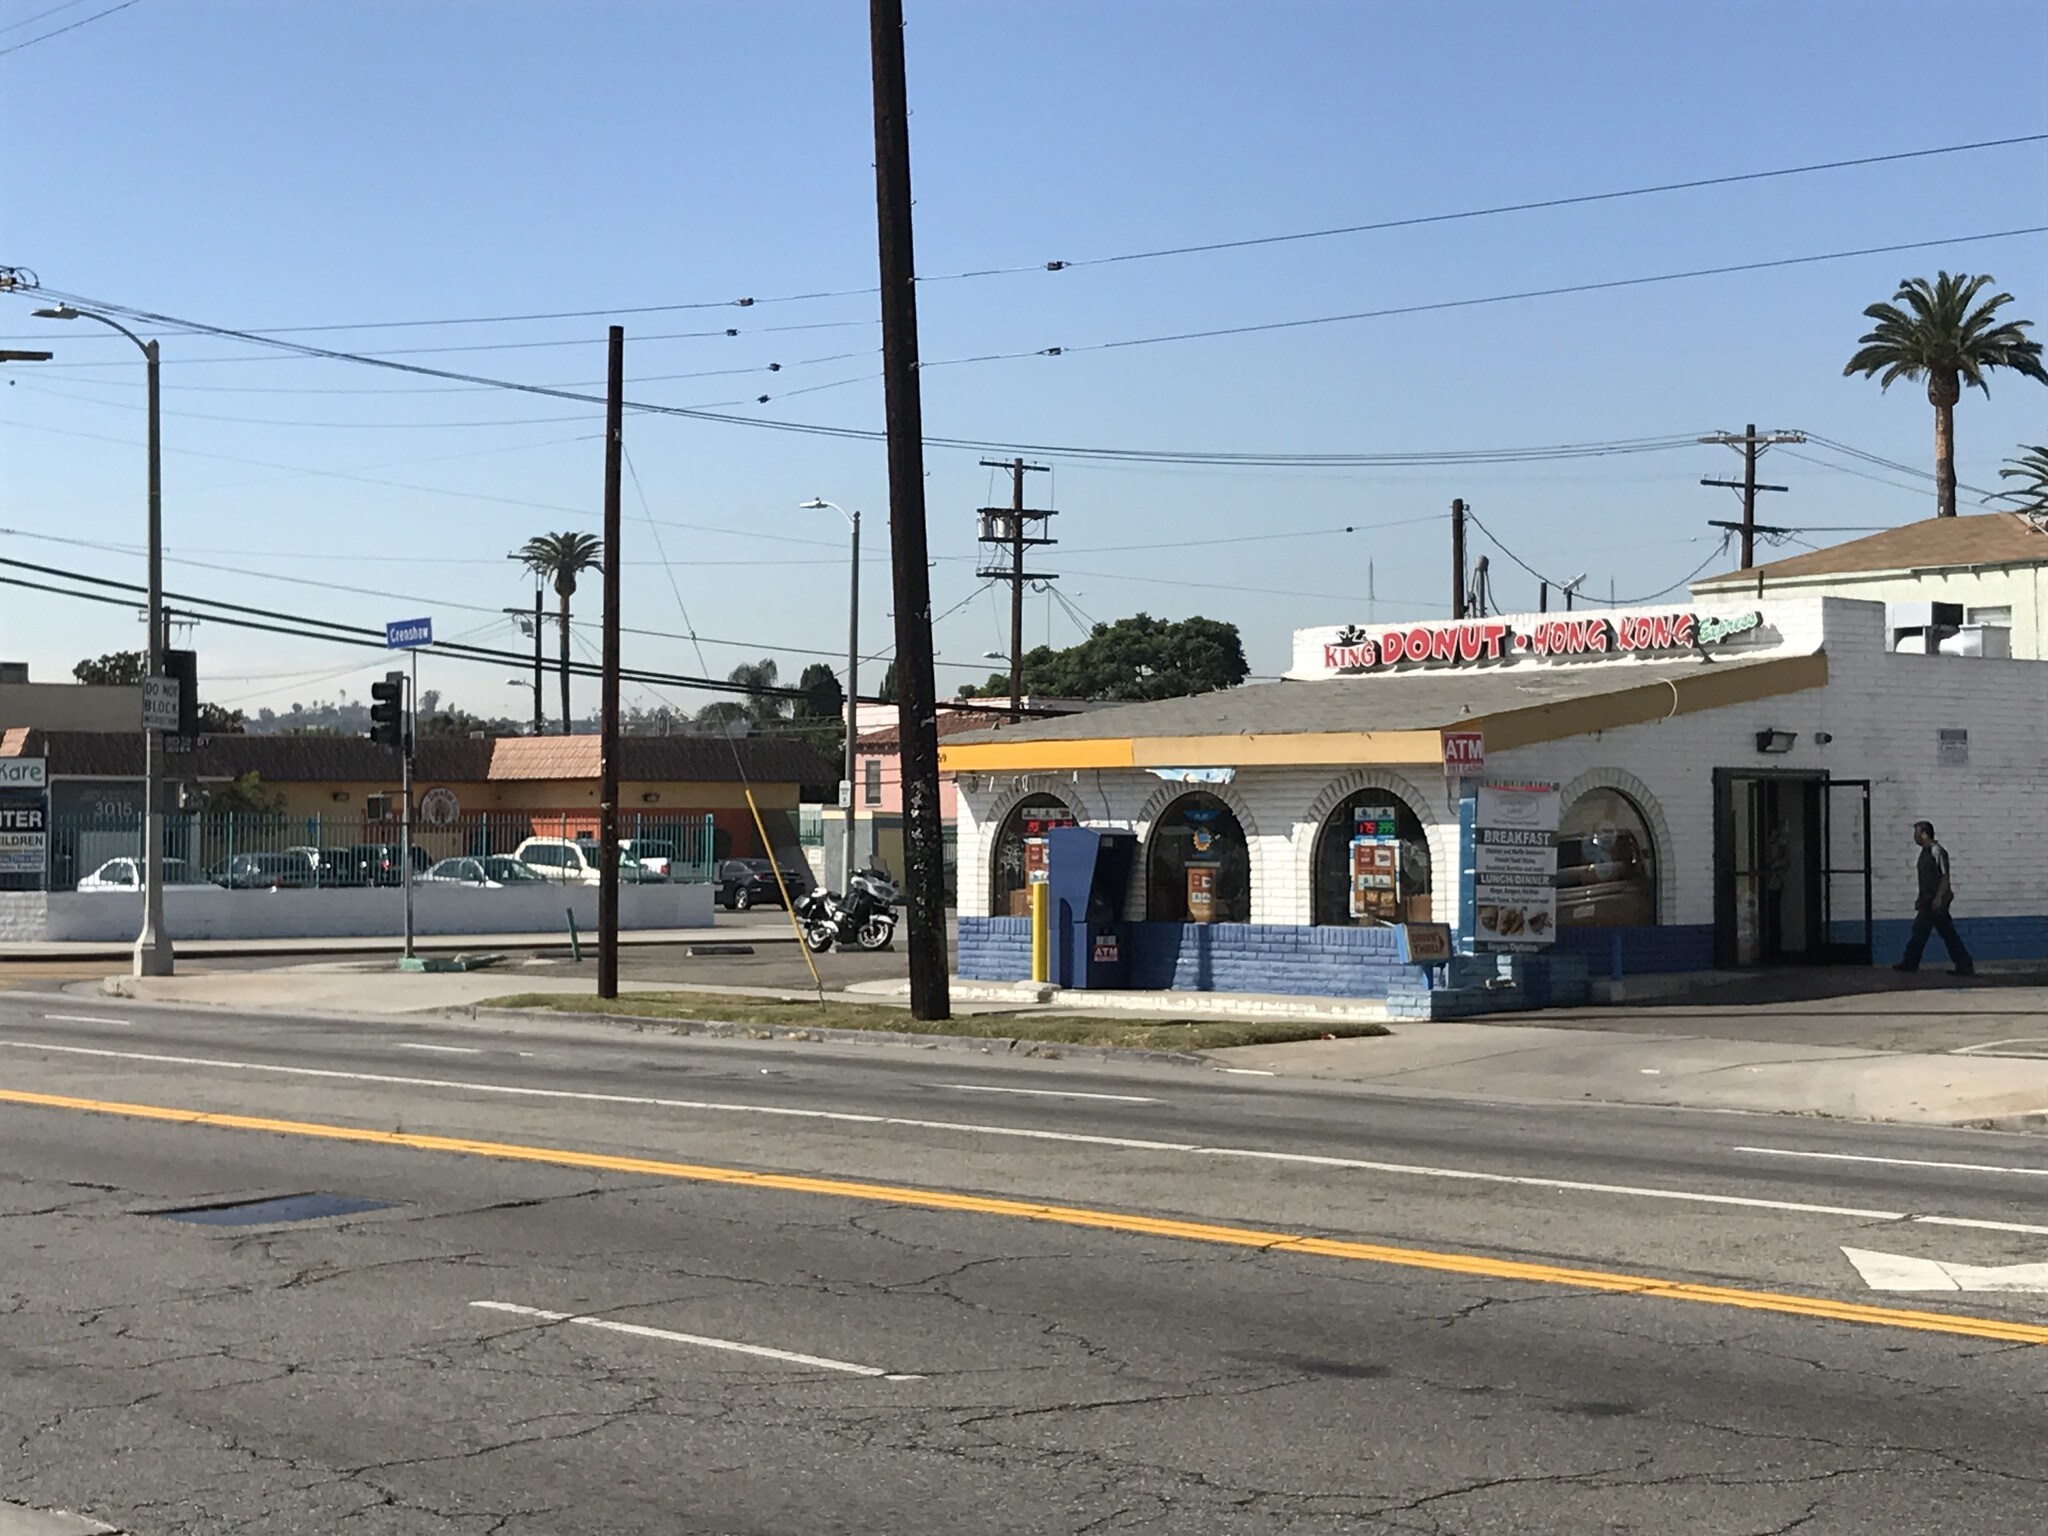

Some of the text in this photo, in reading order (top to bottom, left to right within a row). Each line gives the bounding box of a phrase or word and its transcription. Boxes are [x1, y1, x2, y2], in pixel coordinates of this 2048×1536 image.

[390, 626, 429, 643] Crenshaw
[1533, 611, 1758, 657] HONG KONG Express
[1324, 624, 1506, 668] KING DONUT
[146, 683, 177, 697] DO NOT
[144, 700, 177, 713] BLOCK
[1446, 739, 1482, 760] ATM
[95, 801, 132, 817] 3015
[1483, 830, 1551, 846] BREAKFAST
[1094, 947, 1118, 957] ATM
